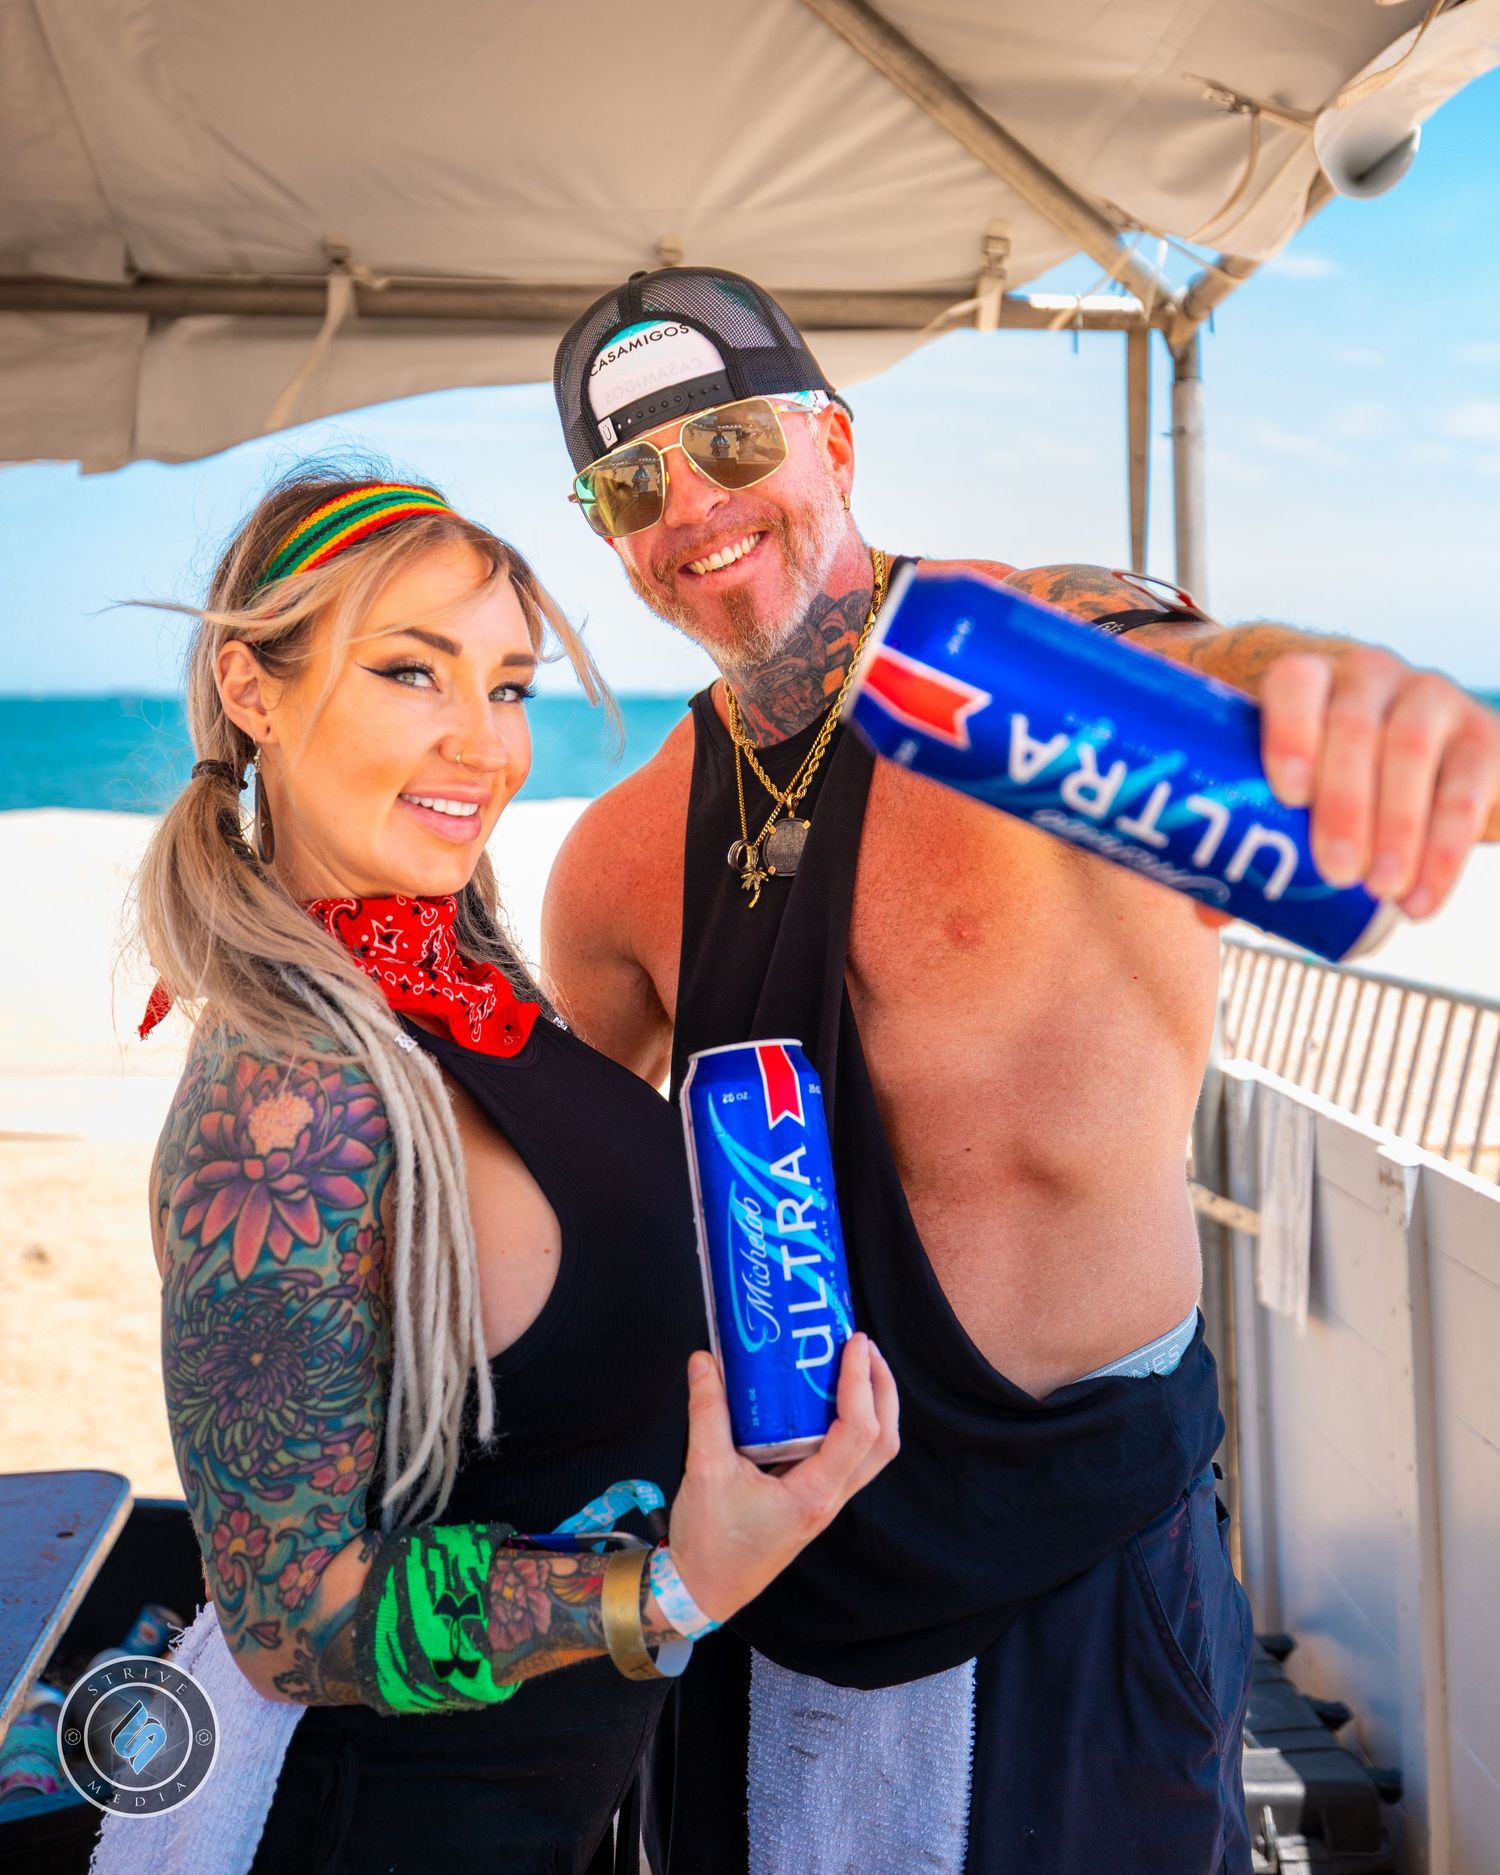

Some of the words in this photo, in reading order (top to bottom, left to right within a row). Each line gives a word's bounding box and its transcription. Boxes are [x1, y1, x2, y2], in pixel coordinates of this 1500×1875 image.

[590, 324, 690, 377] CASAMIGOS
[1008, 713, 1299, 901] ULTRA
[739, 1196, 781, 1343] Michelob
[769, 1144, 835, 1370] ULTRA
